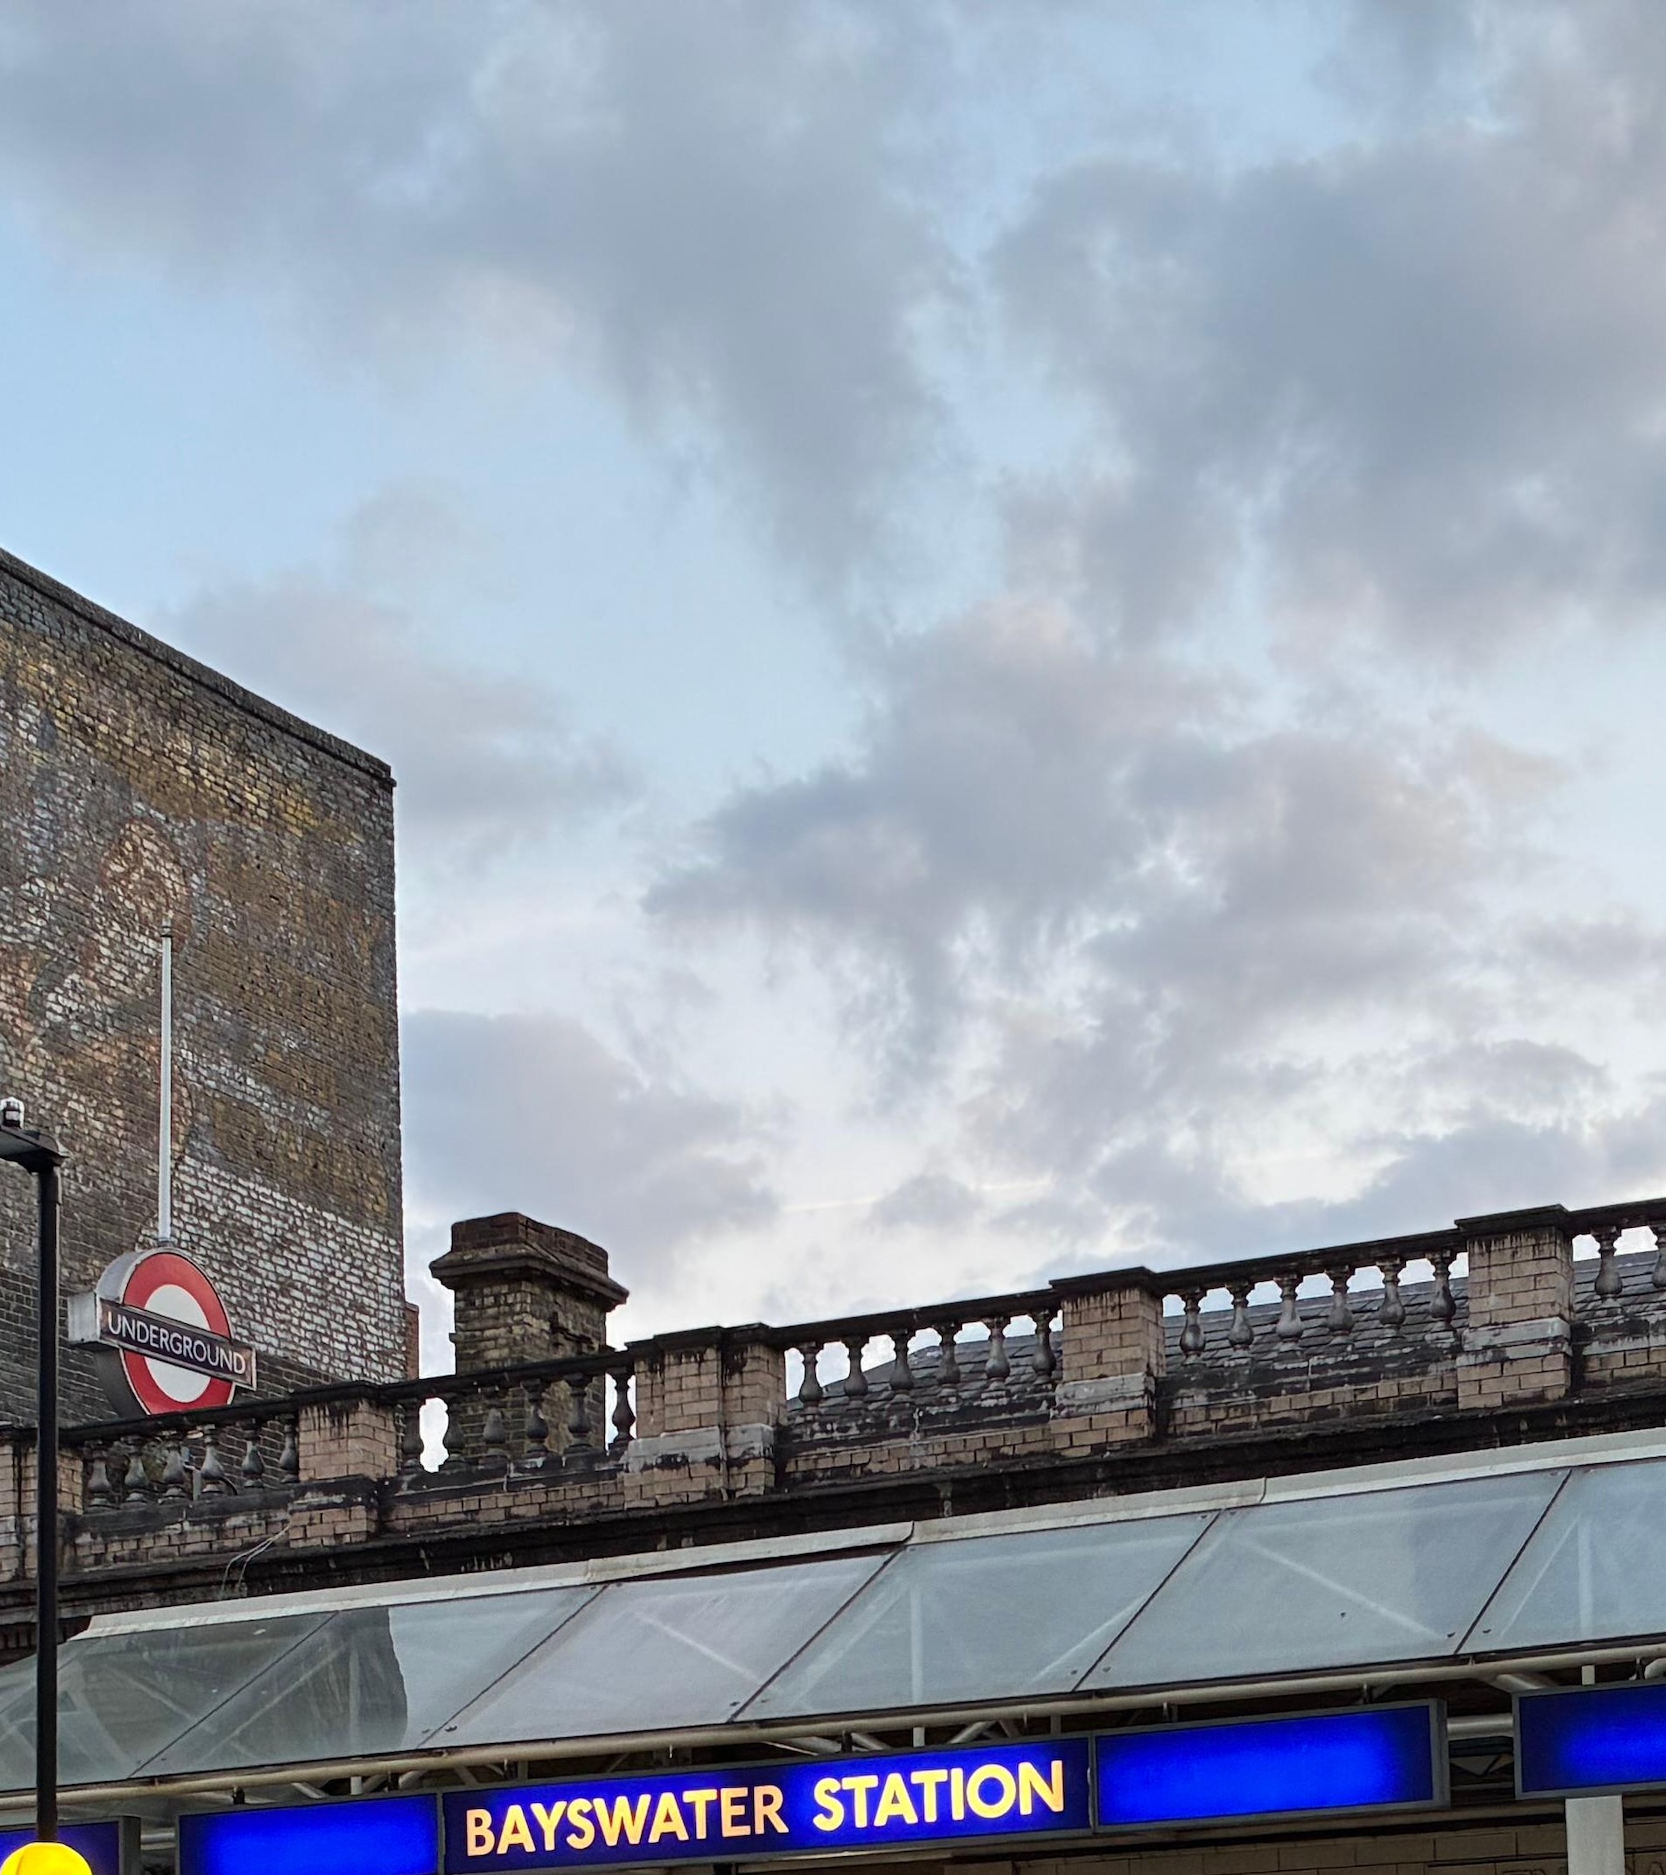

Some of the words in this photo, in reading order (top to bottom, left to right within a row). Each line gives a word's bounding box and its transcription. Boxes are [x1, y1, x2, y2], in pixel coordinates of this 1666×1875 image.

[107, 1310, 246, 1375] UNDERGROUND
[466, 1785, 789, 1857] BAYSWATER
[813, 1760, 1064, 1831] STATION
